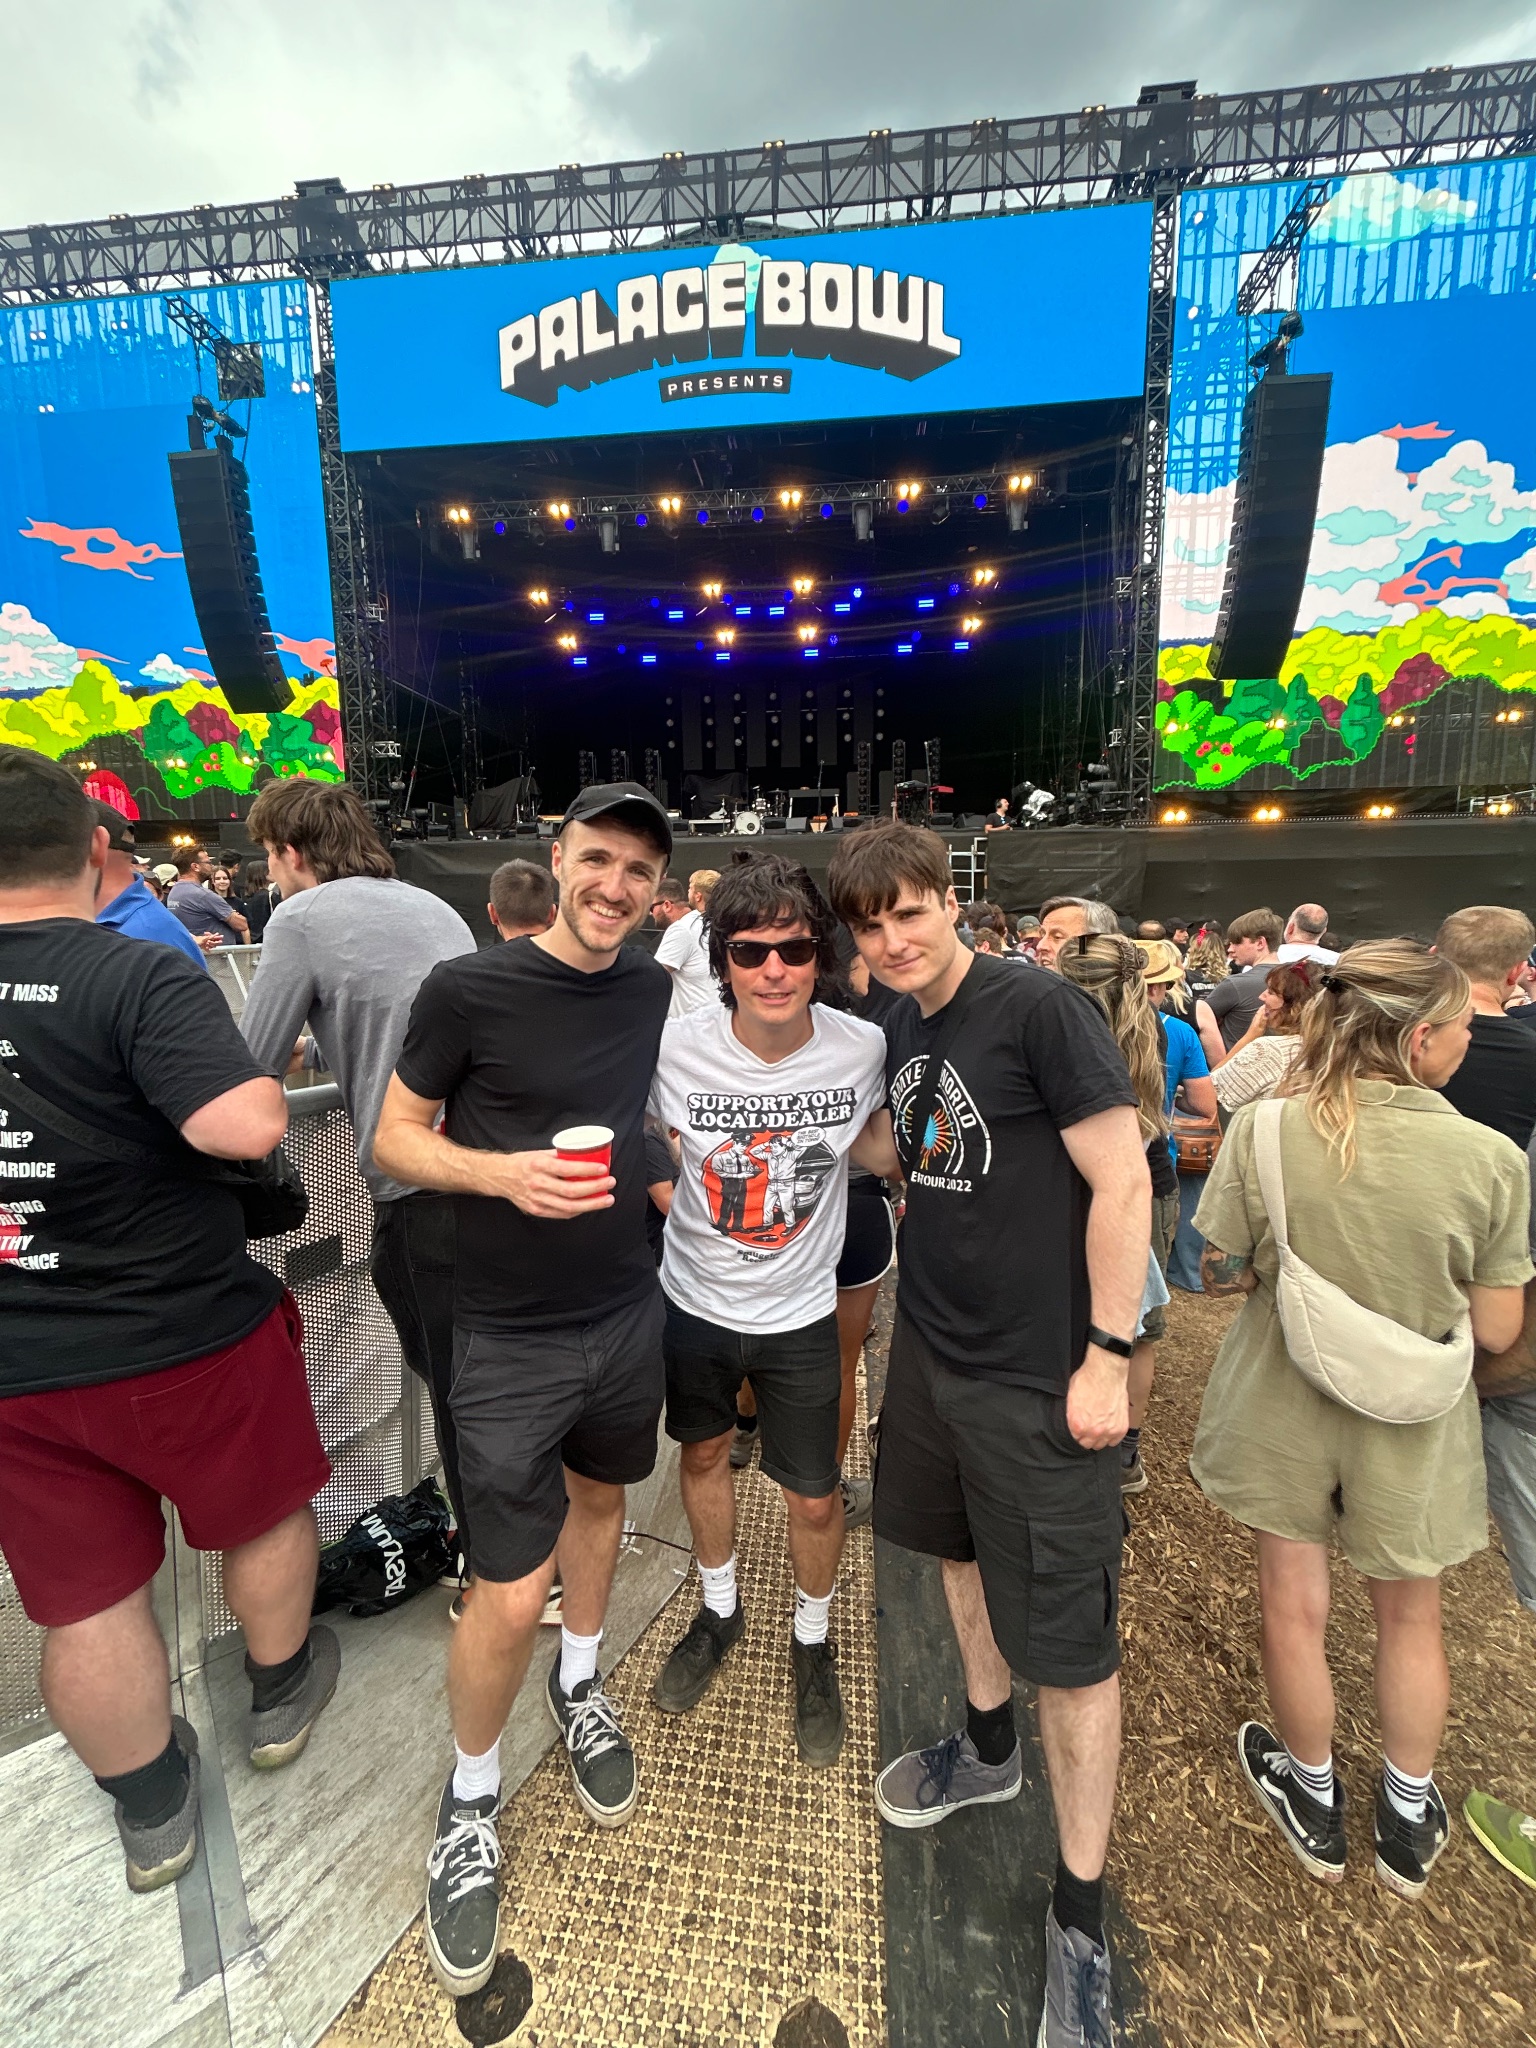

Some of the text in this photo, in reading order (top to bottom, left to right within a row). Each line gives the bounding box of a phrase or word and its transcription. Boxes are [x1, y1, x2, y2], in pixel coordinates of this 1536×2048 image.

[499, 260, 962, 391] PALACE BOWL
[667, 374, 785, 396] PRESENTS
[12, 983, 59, 1003] MASS
[687, 1088, 853, 1112] SUPPORT YOUR
[689, 1106, 852, 1129] LOCAL DEALER
[0, 1213, 28, 1227] RLD
[0, 1234, 35, 1251] THY
